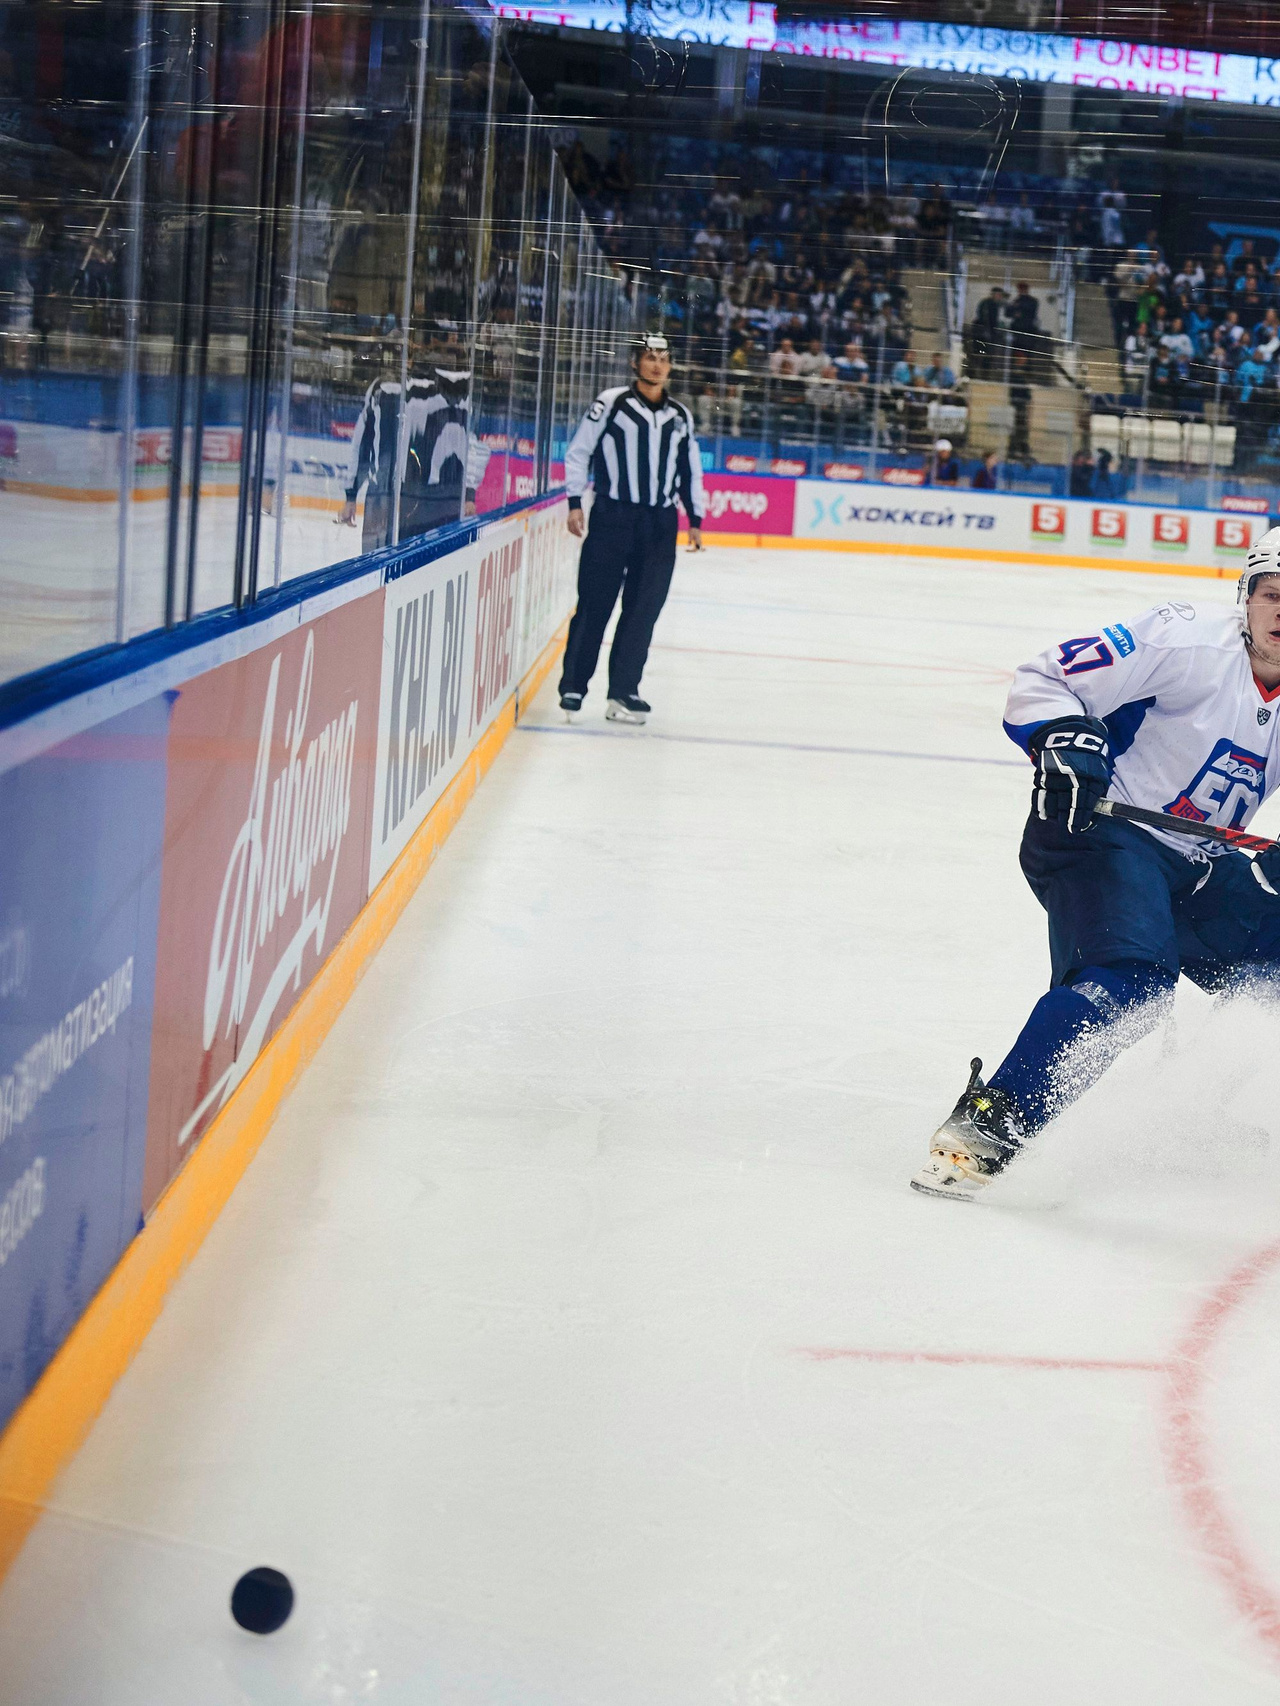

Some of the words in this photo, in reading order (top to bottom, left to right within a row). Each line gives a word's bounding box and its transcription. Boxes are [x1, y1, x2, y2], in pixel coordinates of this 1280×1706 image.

[1073, 37, 1229, 77] FONBET
[848, 503, 957, 528] ХОККЕЙ
[961, 513, 995, 532] ТВ
[1038, 508, 1060, 532] 5
[1098, 511, 1121, 536] 5
[1160, 515, 1182, 540] 5
[1221, 520, 1245, 545] 5
[1057, 636, 1114, 676] 47
[382, 570, 469, 844] KHL.RU
